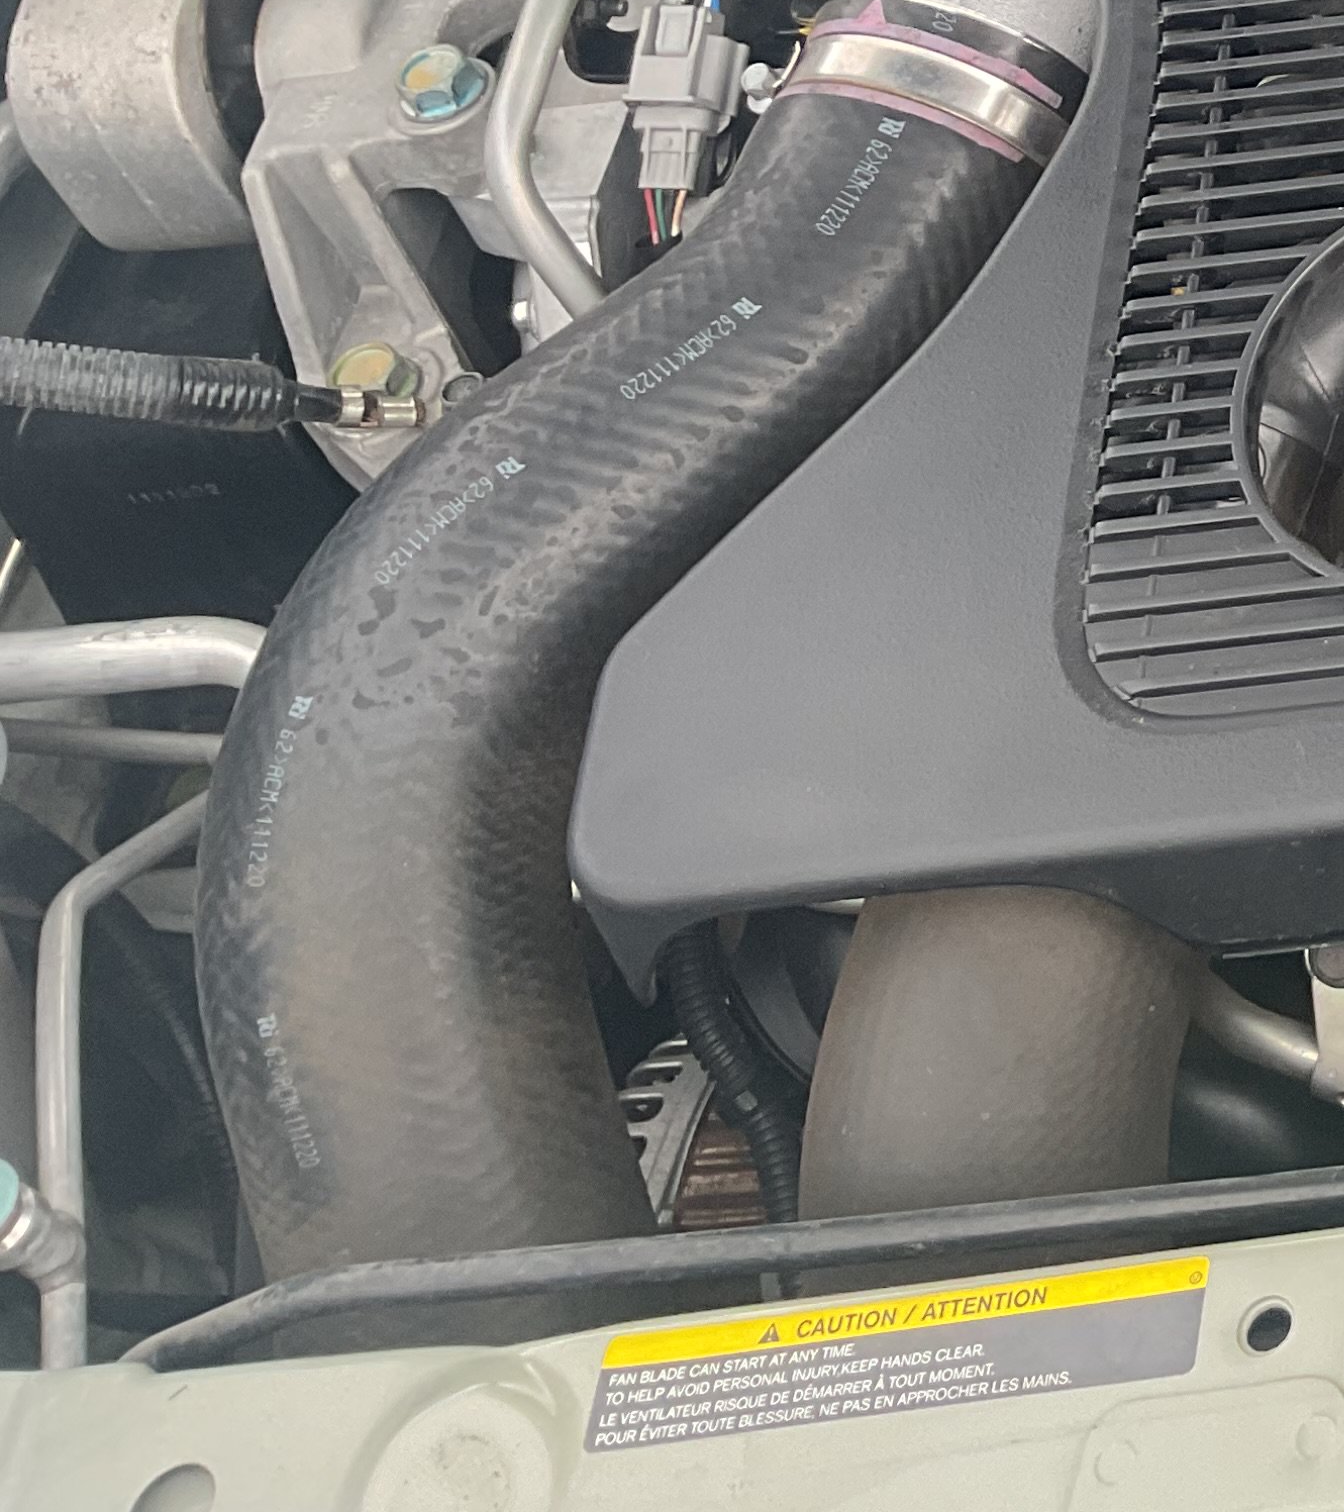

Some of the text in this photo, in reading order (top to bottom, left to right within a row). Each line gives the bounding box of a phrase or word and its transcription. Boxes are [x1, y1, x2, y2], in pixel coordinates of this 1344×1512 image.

[796, 1310, 898, 1340] CAUTION
[921, 1286, 1048, 1324] ATTENTION
[598, 1414, 616, 1426] LE
[620, 1401, 710, 1424] VENTILATEUR
[713, 1394, 768, 1413] RISQUE
[771, 1392, 788, 1404] DE
[792, 1377, 872, 1401] DÉMARRER
[888, 1372, 926, 1388] TOUT
[928, 1363, 994, 1382] MOMENT.
[606, 1392, 624, 1404] TO
[627, 1387, 665, 1402] HELP
[666, 1381, 710, 1397] AVOID
[713, 1371, 787, 1392] PERSONAL
[880, 1351, 931, 1368] HANDS
[934, 1343, 984, 1361] CLEAR.
[608, 1344, 855, 1386] FAN BLADE CAN START AT ANY TIME.
[594, 1372, 1071, 1446] POUR ÉVITER TOUTE BLESSURE, NE PAS EN APPROCHER LES MAINS.
